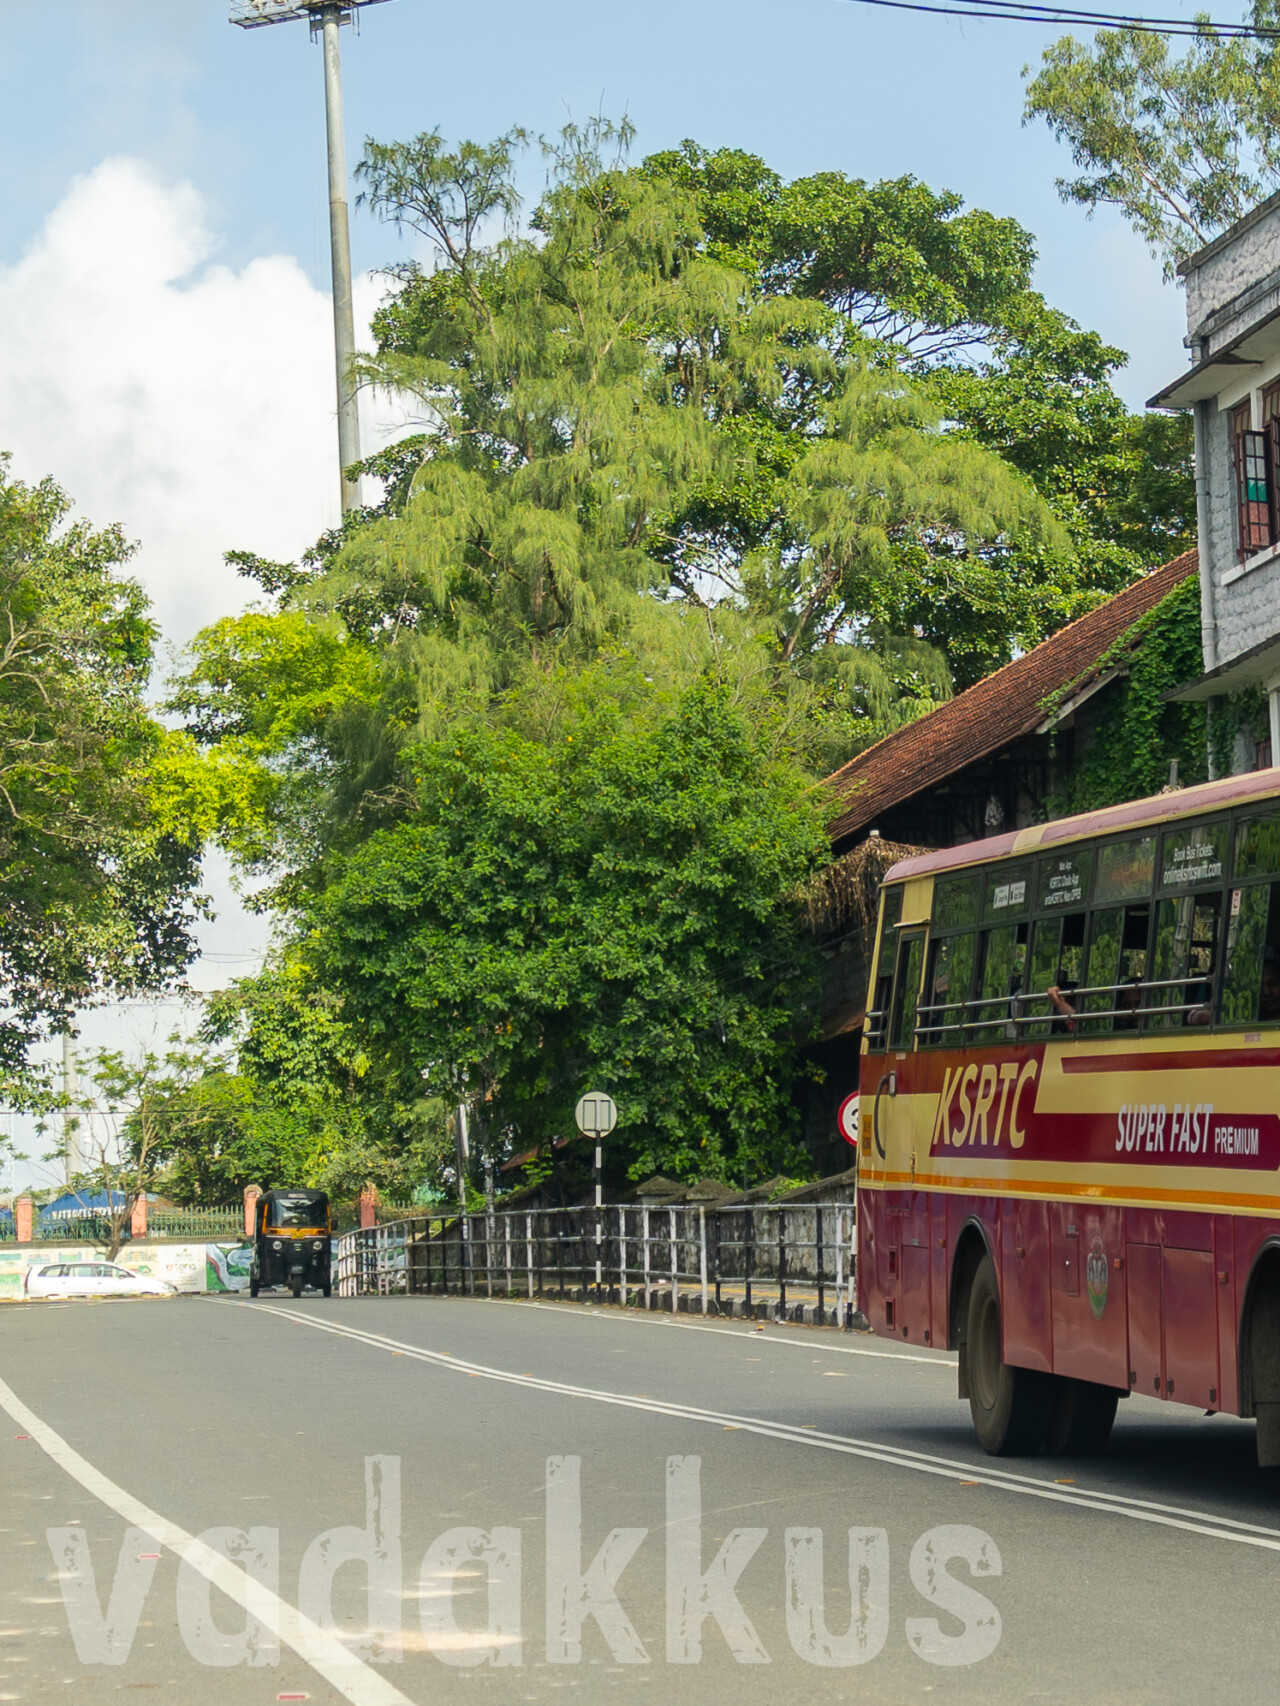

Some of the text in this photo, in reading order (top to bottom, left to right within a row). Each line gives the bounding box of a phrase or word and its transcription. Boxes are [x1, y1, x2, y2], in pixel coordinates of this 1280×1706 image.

[932, 1058, 1038, 1149] KSRTC
[1115, 1102, 1259, 1155] SUPER FAST PREMIUM
